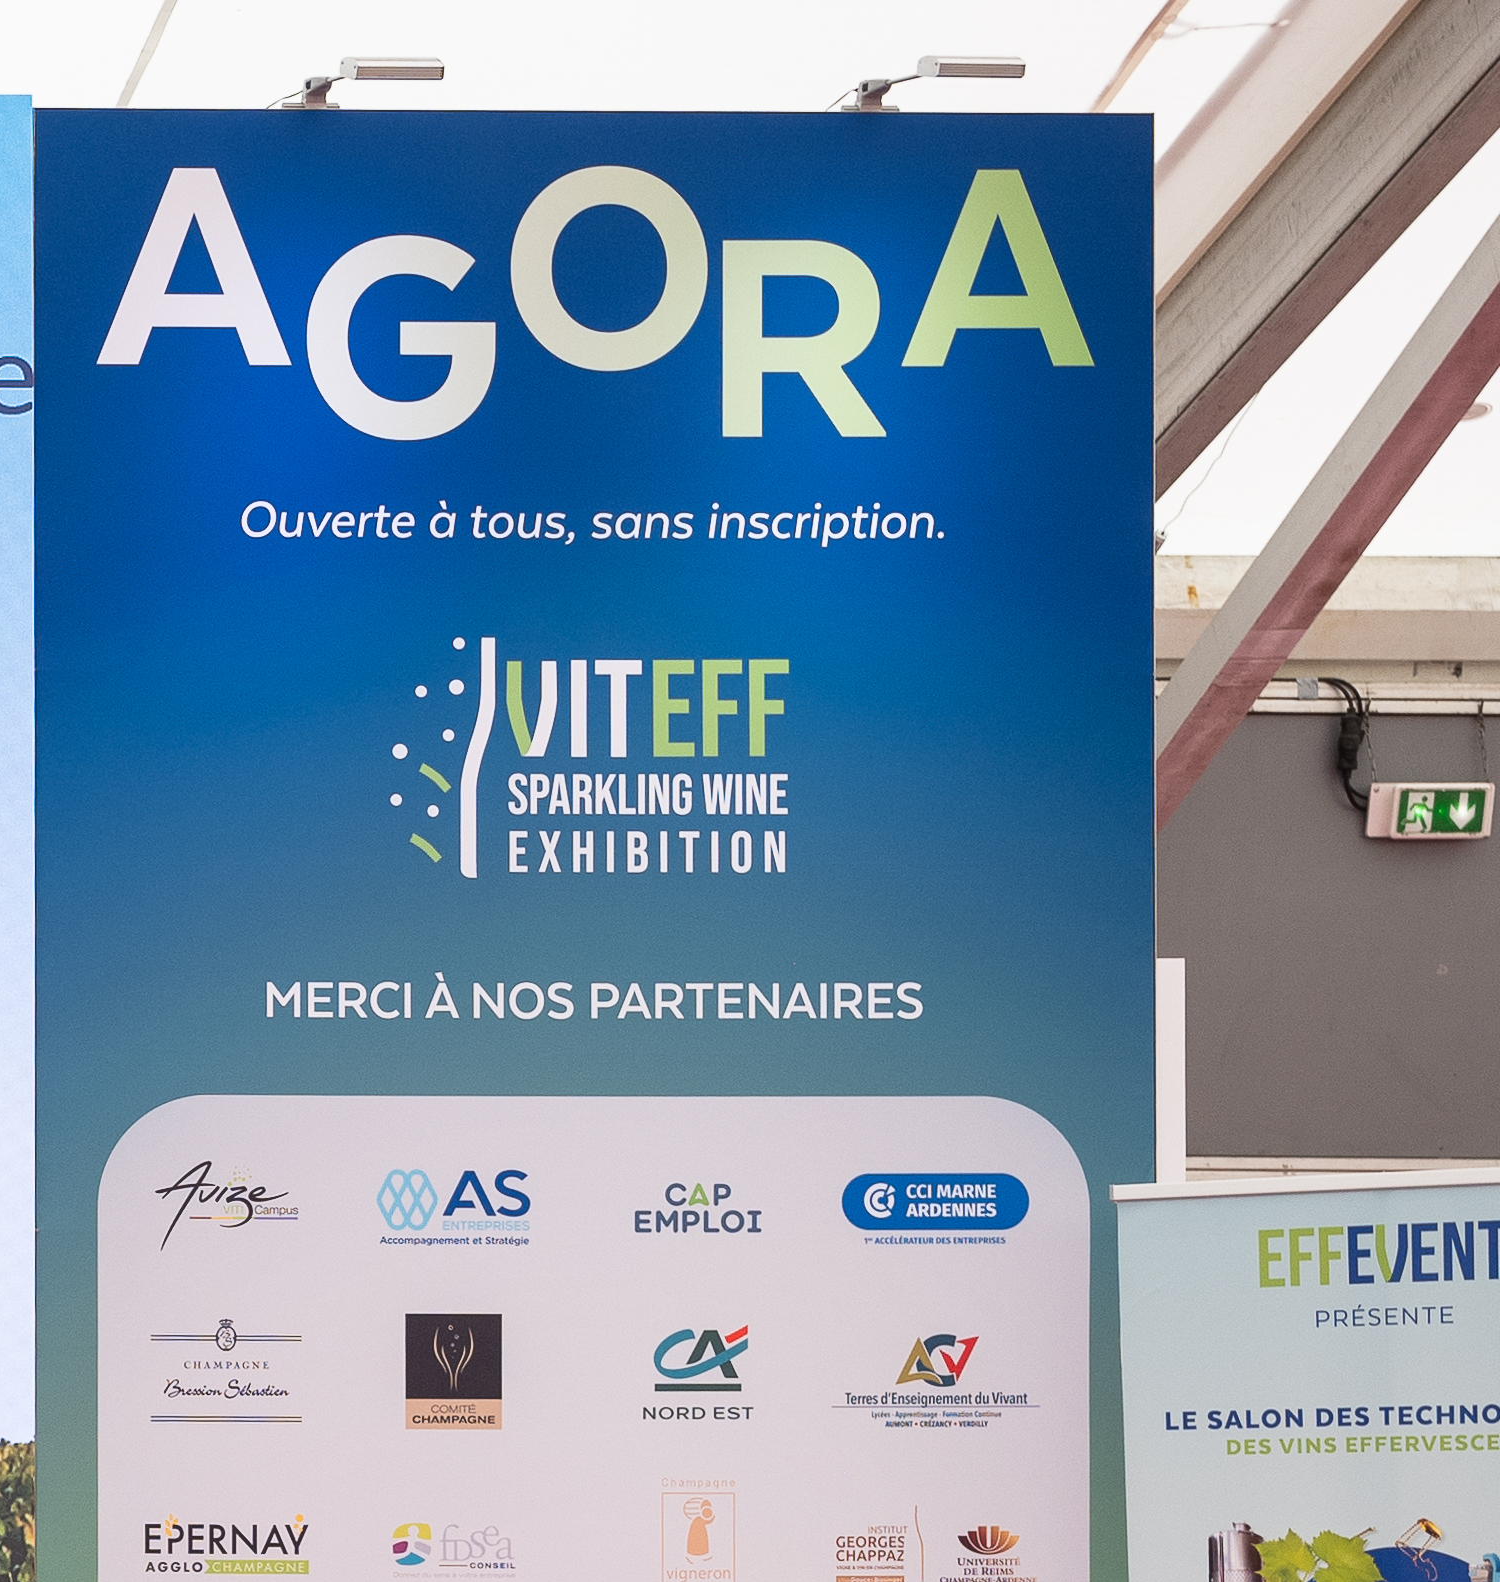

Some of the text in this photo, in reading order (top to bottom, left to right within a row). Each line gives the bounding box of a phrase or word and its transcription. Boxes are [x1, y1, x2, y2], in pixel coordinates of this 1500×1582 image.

[97, 166, 1094, 440] AGORA
[242, 500, 944, 547] Ouverte à tous, sans inscription.
[506, 659, 789, 757] VITEFF
[508, 773, 788, 815] SPARKLING WINE
[509, 831, 785, 873] EXHIBITION
[267, 972, 923, 1019] MERCI À NOS PARTENAIRES
[443, 1170, 530, 1217] AS
[665, 1183, 731, 1206] CAP
[906, 1184, 996, 1198] CCI MARNE
[635, 1210, 762, 1233] EMPLOI
[906, 1203, 996, 1217] ARDENNES
[443, 1221, 530, 1231] ENTREPRISES
[380, 1236, 469, 1246] Accompagnement
[486, 1237, 529, 1246] Stratégie
[1258, 1221, 1500, 1287] EFFEVENT
[1316, 1304, 1453, 1328] PRÉSENTE
[431, 1404, 476, 1414] COMITÉ
[845, 1393, 878, 1405] Terres
[975, 1392, 989, 1404] du
[992, 1392, 1027, 1404] Vivant
[412, 1415, 495, 1424] CHAMPAGNE
[643, 1407, 753, 1420] NORD EST
[1166, 1411, 1197, 1430] LE
[1208, 1409, 1303, 1429] SALON
[1316, 1407, 1369, 1427] DES
[1227, 1439, 1271, 1455] DES
[1279, 1437, 1336, 1454] VINS
[145, 1524, 308, 1554] EPERNAY
[836, 1536, 904, 1548] GEORGES
[836, 1550, 904, 1561] CHAPPAZ
[146, 1562, 305, 1573] AGGLO CHAMPAGNE
